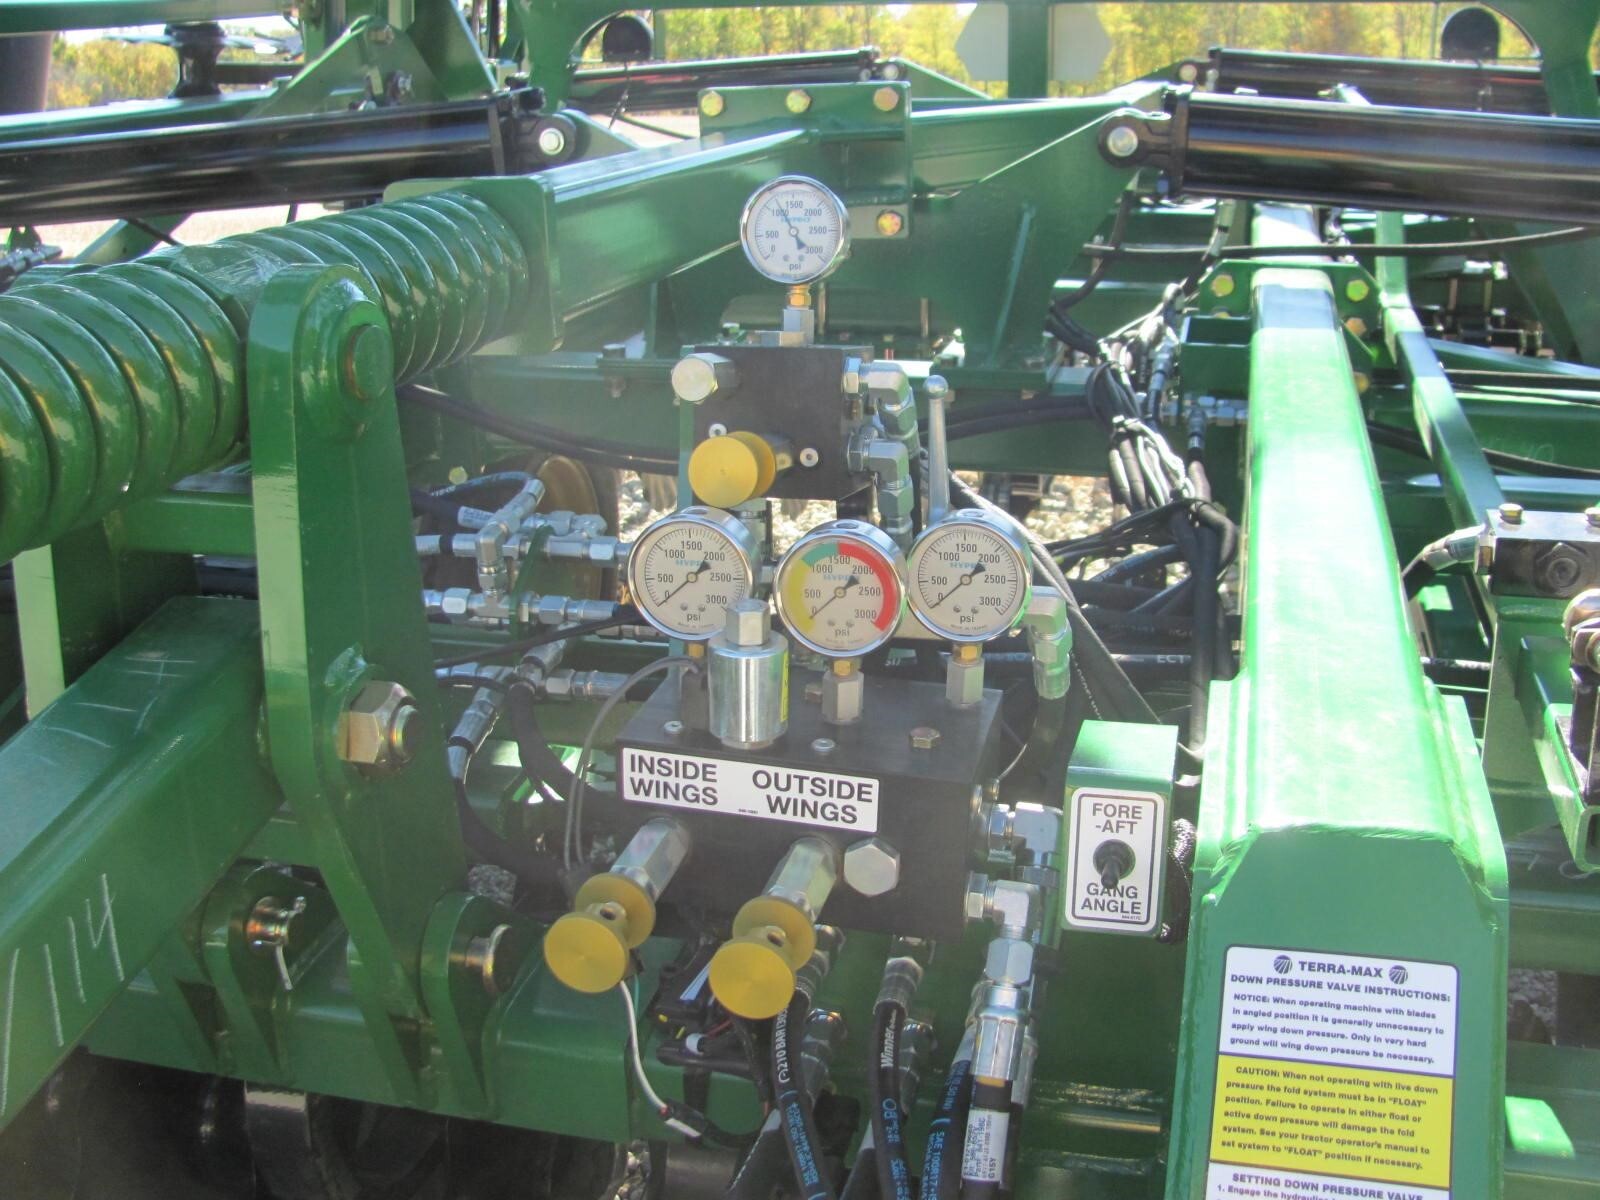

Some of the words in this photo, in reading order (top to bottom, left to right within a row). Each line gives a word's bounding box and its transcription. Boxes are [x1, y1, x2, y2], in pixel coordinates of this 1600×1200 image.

[786, 201, 803, 209] 1500
[765, 231, 779, 239] 500
[809, 226, 827, 234] 2500
[806, 246, 824, 254] 3000
[789, 263, 802, 271] psi
[680, 541, 702, 551] 1500
[956, 544, 977, 553] 1500
[664, 549, 685, 559] 1000
[703, 552, 725, 561] 2000
[939, 552, 960, 561] 1000
[978, 554, 1000, 563] 2000
[829, 556, 851, 564] 1500
[812, 564, 832, 573] 1000
[852, 565, 873, 574] 2000
[657, 574, 674, 583] 500
[710, 572, 732, 582] 2500
[932, 577, 947, 585] 500
[984, 575, 1006, 584] 2500
[665, 590, 670, 599] 0
[805, 589, 821, 598] 500
[859, 587, 880, 596] 2500
[706, 594, 727, 605] 3000
[938, 593, 943, 601] 0
[979, 597, 1001, 606] 3000
[812, 606, 816, 614] 0
[855, 609, 876, 619] 3000
[686, 614, 701, 622] psi
[960, 615, 974, 624] psi
[835, 629, 850, 637] psi
[630, 754, 718, 783] INSIDE
[630, 777, 718, 806] WINGS
[752, 770, 873, 803] OUTSIDE
[766, 794, 858, 824] WINGS
[1092, 803, 1143, 820] FORE
[1096, 820, 1138, 835] -AFT
[1087, 882, 1138, 899] GANG
[1081, 898, 1141, 915] ANGLE
[1298, 959, 1383, 978] TERRA-MAX
[1230, 973, 1263, 984] DOWN
[1266, 976, 1323, 989] PRESSURE
[1326, 980, 1361, 992] VALVE
[1364, 984, 1450, 1002] INSTRUCTIONS:
[1233, 992, 1270, 1003] NOTICE:
[1272, 995, 1296, 1005] When
[1299, 999, 1341, 1010] operating
[1343, 1003, 1382, 1013] machine
[1385, 1006, 1404, 1015] with
[1406, 1008, 1436, 1019] blades
[1231, 1006, 1240, 1015] in
[1243, 1008, 1272, 1018] angled
[1274, 1011, 1309, 1021] position
[1311, 1013, 1318, 1023] it
[1320, 1014, 1329, 1024] is
[1331, 1016, 1373, 1028] generally
[1375, 1021, 1432, 1034] unnecessary
[1434, 1026, 1444, 1035] to
[776, 1028, 786, 1050] BAR
[1231, 1022, 1254, 1031] apply
[1257, 1023, 1277, 1034] wing
[1280, 1025, 1304, 1035] down
[1306, 1029, 1348, 1039] pressure.
[1351, 1032, 1371, 1043] Only
[1372, 1034, 1382, 1044] in
[1384, 1037, 1404, 1046] very
[1406, 1038, 1426, 1047] hard
[881, 1028, 894, 1068] Winner
[1230, 1036, 1260, 1045] ground
[1262, 1039, 1278, 1047] will
[1280, 1040, 1301, 1051] wing
[1304, 1042, 1328, 1052] down
[1330, 1046, 1370, 1056] pressure
[1371, 1049, 1384, 1059] be
[1386, 1051, 1434, 1064] necessary.
[1236, 1065, 1279, 1077] CAUTION:
[1282, 1069, 1307, 1080] When
[1309, 1074, 1324, 1082] not
[1327, 1075, 1370, 1088] operating
[1373, 1080, 1392, 1089] with
[1395, 1081, 1411, 1091] live
[1413, 1084, 1438, 1094] down
[1226, 1080, 1264, 1091] pressure
[1266, 1083, 1281, 1092] the
[1283, 1085, 1300, 1094] fold
[1303, 1088, 1336, 1098] system
[1338, 1092, 1361, 1101] must
[1362, 1093, 1375, 1103] be
[1377, 1094, 1386, 1104] in
[1388, 1096, 1426, 1107] "FLOAT"
[1225, 1095, 1262, 1105] position.
[1265, 1098, 1296, 1109] Failure
[1297, 1102, 1308, 1111] to
[1310, 1104, 1345, 1114] operate
[1347, 1106, 1357, 1116] in
[1359, 1108, 1386, 1118] either
[1389, 1111, 1409, 1121] float
[1411, 1115, 1421, 1124] or
[1224, 1109, 1251, 1119] active
[1253, 1112, 1277, 1122] down
[1280, 1115, 1319, 1126] pressure
[1322, 1120, 1338, 1128] will
[1340, 1121, 1377, 1133] damage
[1380, 1125, 1394, 1135] the
[1397, 1127, 1414, 1137] fold
[1222, 1124, 1256, 1134] system.
[1259, 1127, 1276, 1136] See
[1279, 1131, 1299, 1139] your
[1301, 1132, 1333, 1143] tractor
[1335, 1137, 1381, 1149] operator's
[1384, 1143, 1418, 1153] manual
[1419, 1146, 1430, 1155] to
[1221, 1139, 1235, 1147] set
[1237, 1141, 1269, 1151] system
[1271, 1144, 1281, 1153] to
[1284, 1145, 1322, 1157] "FLOAT"
[1325, 1151, 1362, 1162] position
[1363, 1154, 1371, 1164] if
[1373, 1156, 1422, 1169] necessary.
[1232, 1172, 1280, 1187] SETTING
[1284, 1178, 1319, 1192] DOWN
[1322, 1183, 1383, 1199] PRESSURE
[1228, 1185, 1261, 1196] Engage
[1263, 1189, 1279, 1199] the
